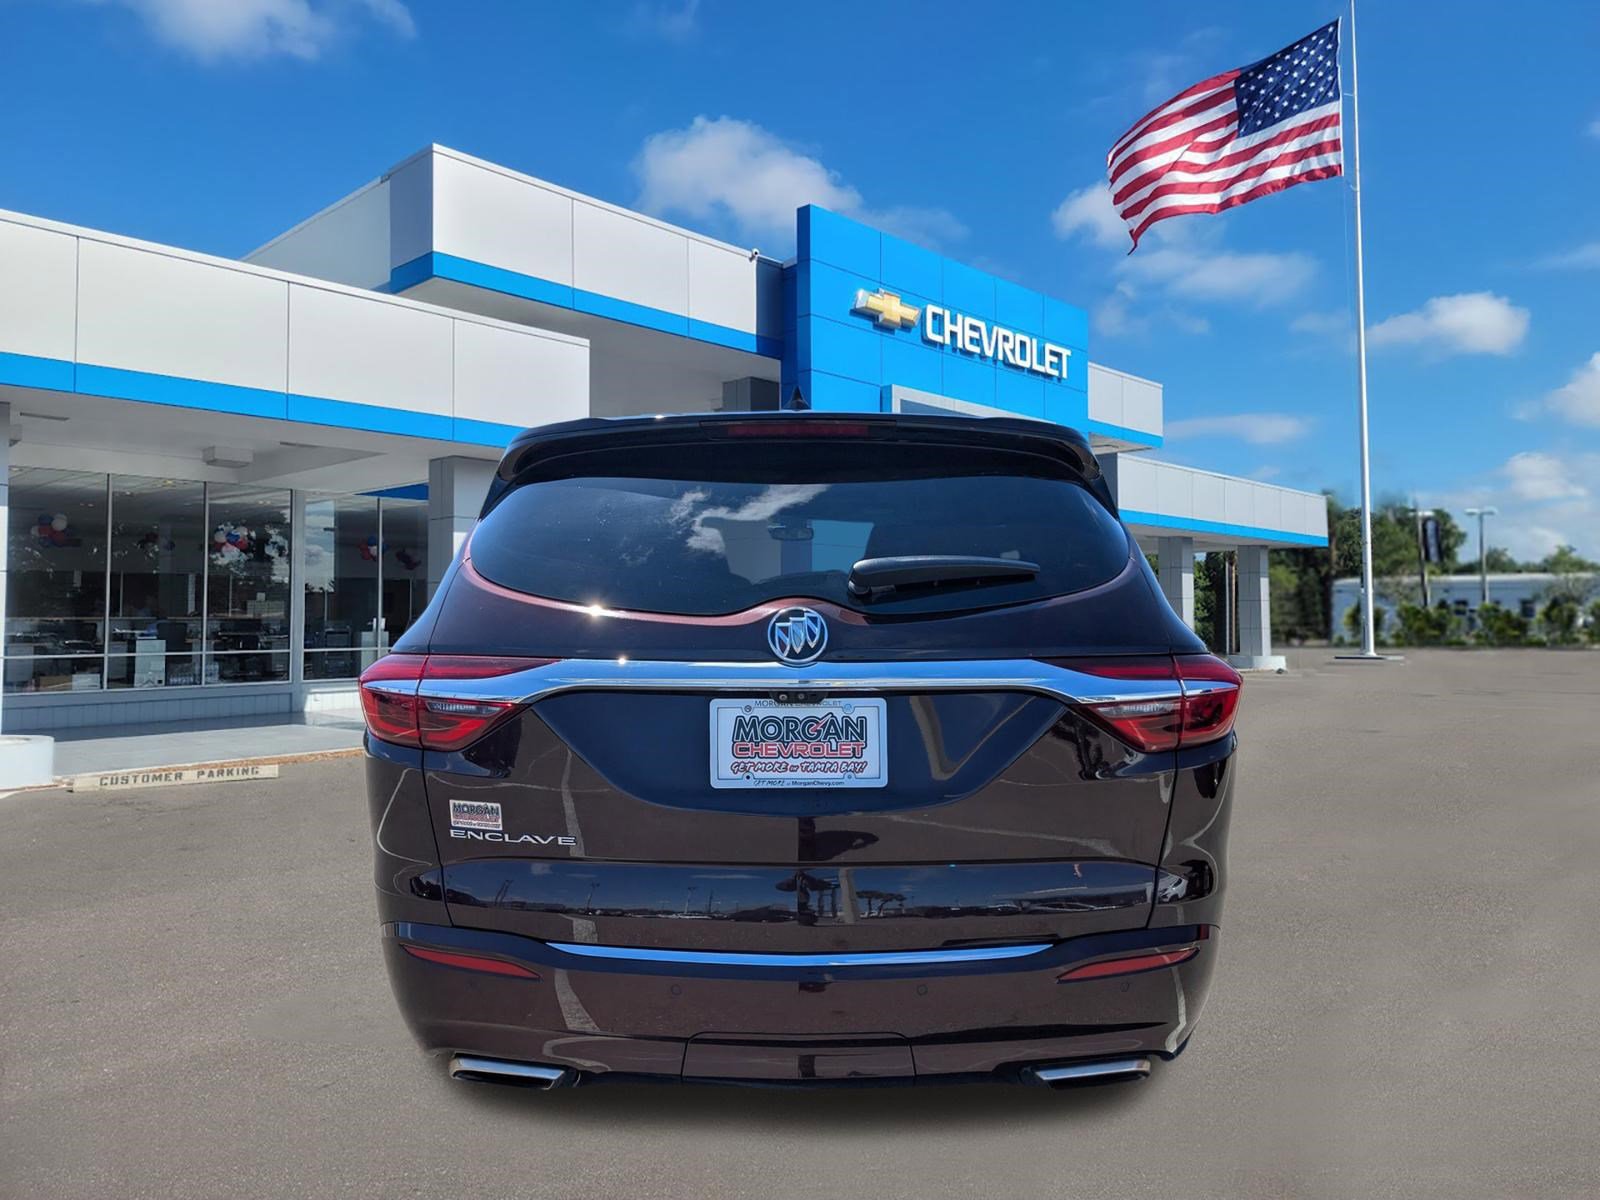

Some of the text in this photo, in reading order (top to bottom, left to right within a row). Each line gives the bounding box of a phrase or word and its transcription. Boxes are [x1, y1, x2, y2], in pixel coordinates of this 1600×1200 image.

[924, 304, 1071, 379] CHEVROLET
[733, 713, 867, 742] MORGAN
[733, 741, 867, 758] CHEVROLET
[731, 761, 754, 774] GET
[754, 761, 788, 773] MORE
[801, 761, 840, 773] TAMPA
[840, 761, 868, 774] BAY!
[99, 766, 260, 787] CUSTOMER PARKING
[453, 802, 500, 816] MORGAN
[450, 829, 577, 845] ENCLAVE
